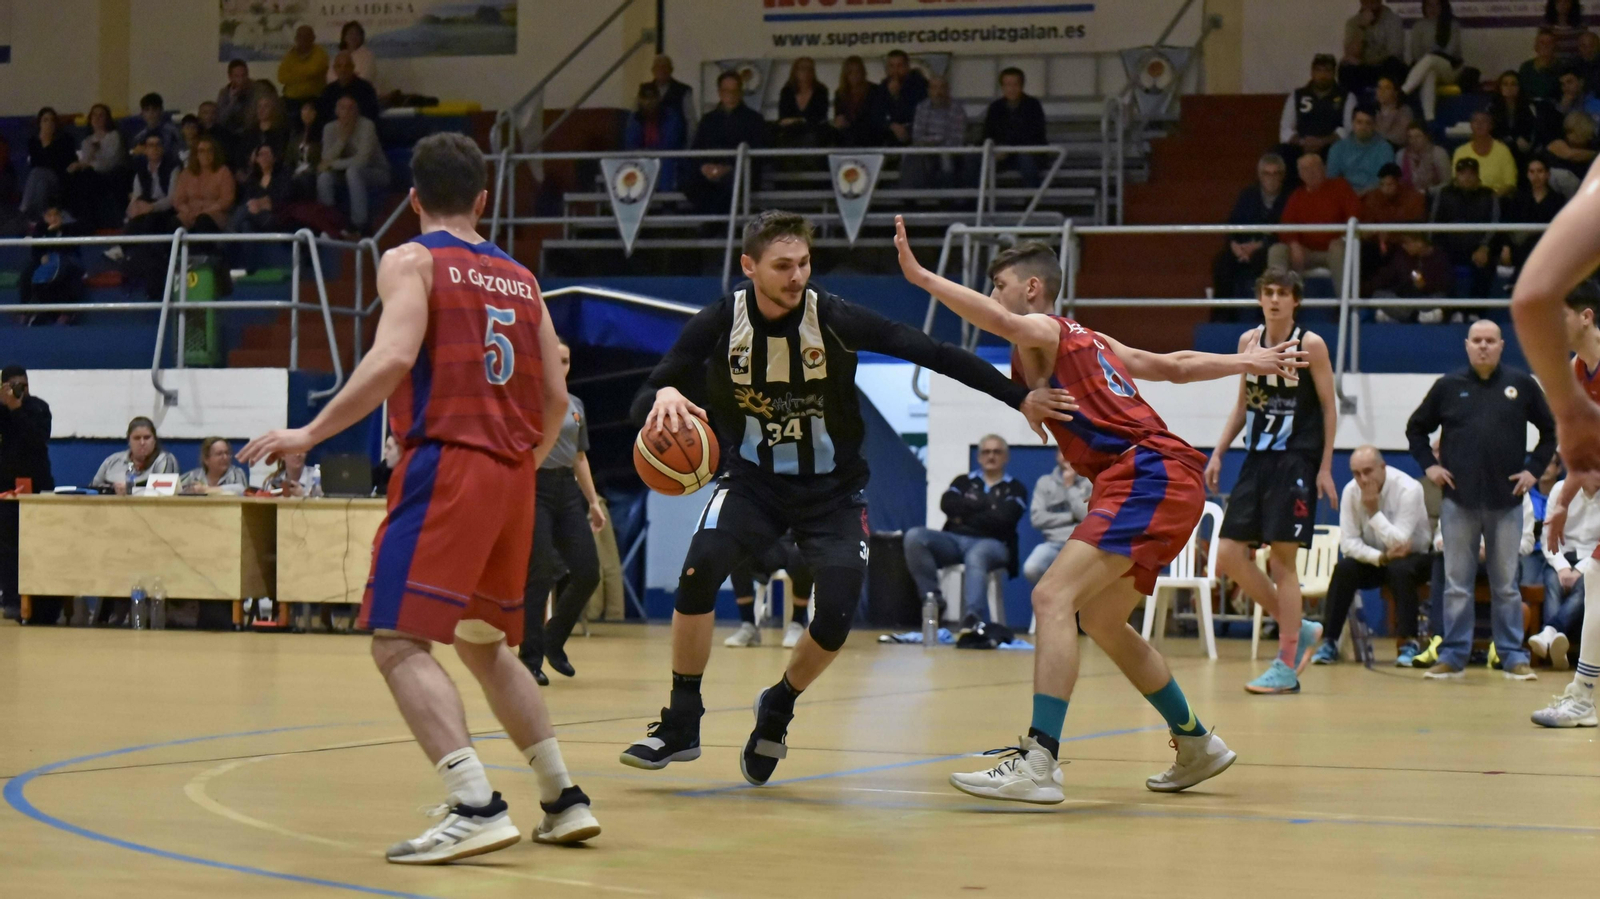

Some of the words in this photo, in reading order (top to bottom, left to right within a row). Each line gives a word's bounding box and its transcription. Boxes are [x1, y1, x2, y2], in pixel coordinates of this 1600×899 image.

[319, 3, 415, 16] ALCAIDESA
[772, 24, 1086, 47] www.supermercadosruizgalan.es
[1299, 96, 1313, 113] 5
[448, 266, 466, 284] D.
[484, 303, 516, 386] 5
[1097, 349, 1137, 398] 6
[766, 418, 803, 447] 34
[1264, 413, 1277, 434] 7
[1294, 523, 1303, 538] 7
